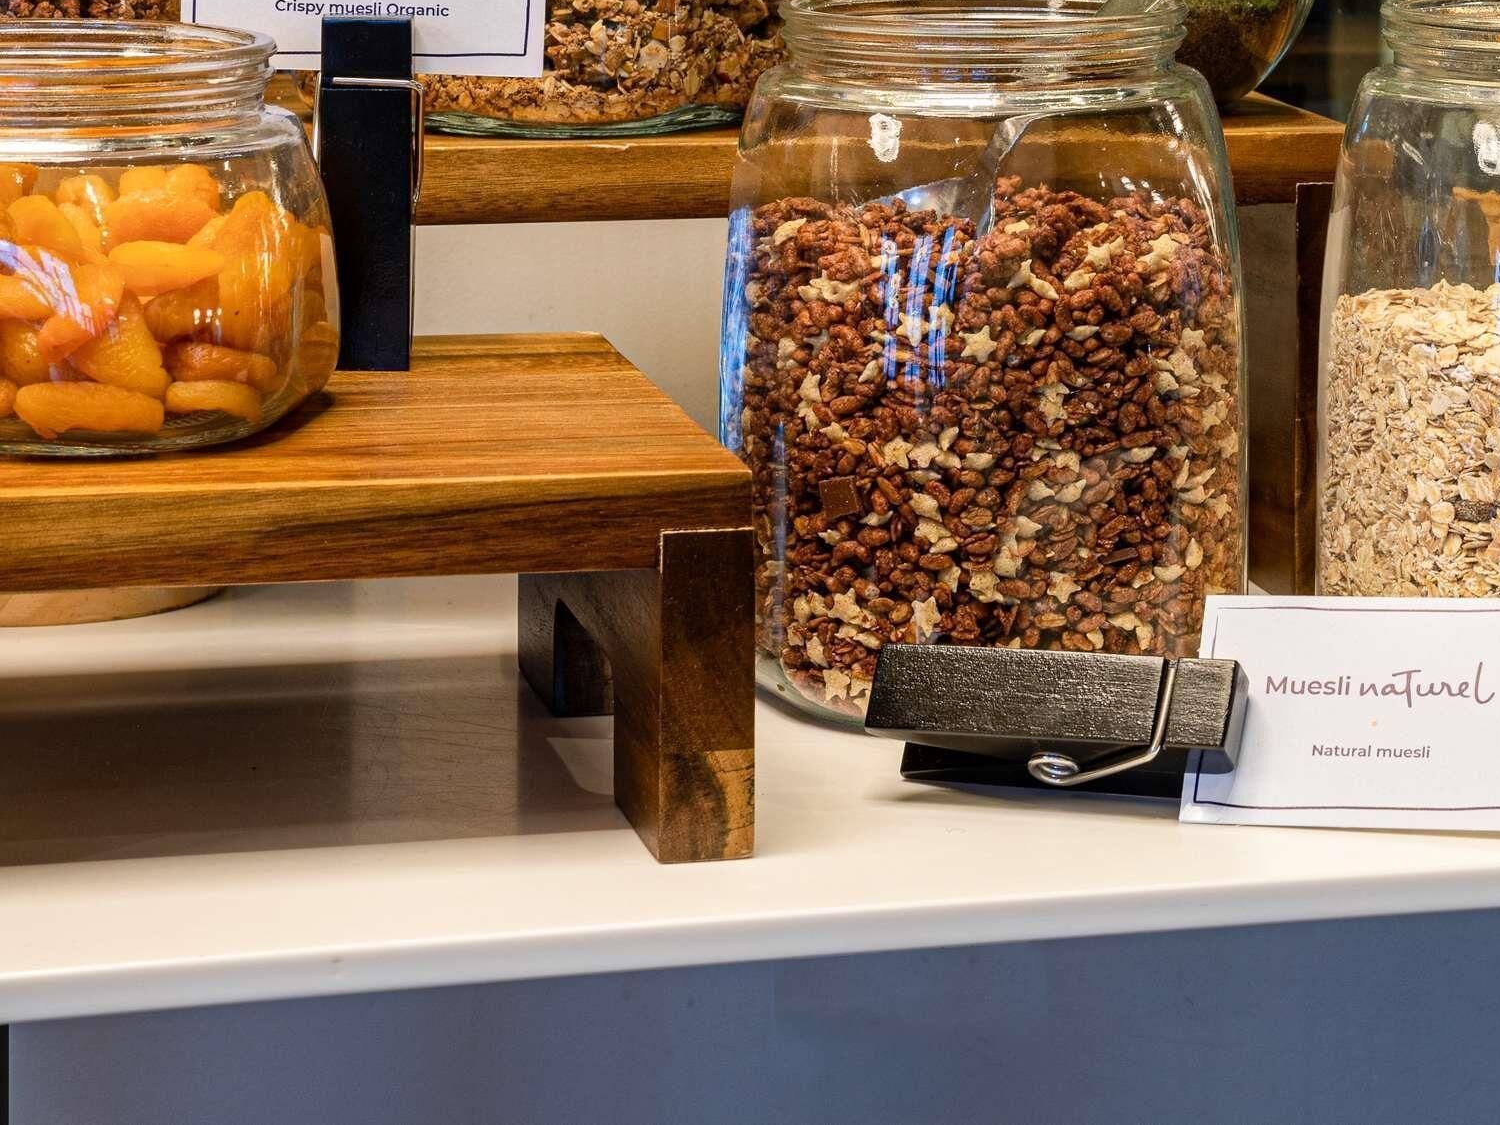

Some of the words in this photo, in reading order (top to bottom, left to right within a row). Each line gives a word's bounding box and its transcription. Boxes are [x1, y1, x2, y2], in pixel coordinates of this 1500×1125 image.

[275, 0, 325, 16] Crispy
[329, 1, 381, 15] muesli
[386, 3, 450, 17] Organic
[1264, 675, 1351, 697] Muesli
[1359, 661, 1495, 709] naturel
[1311, 744, 1372, 759] Natural
[1376, 744, 1431, 760] muesli
